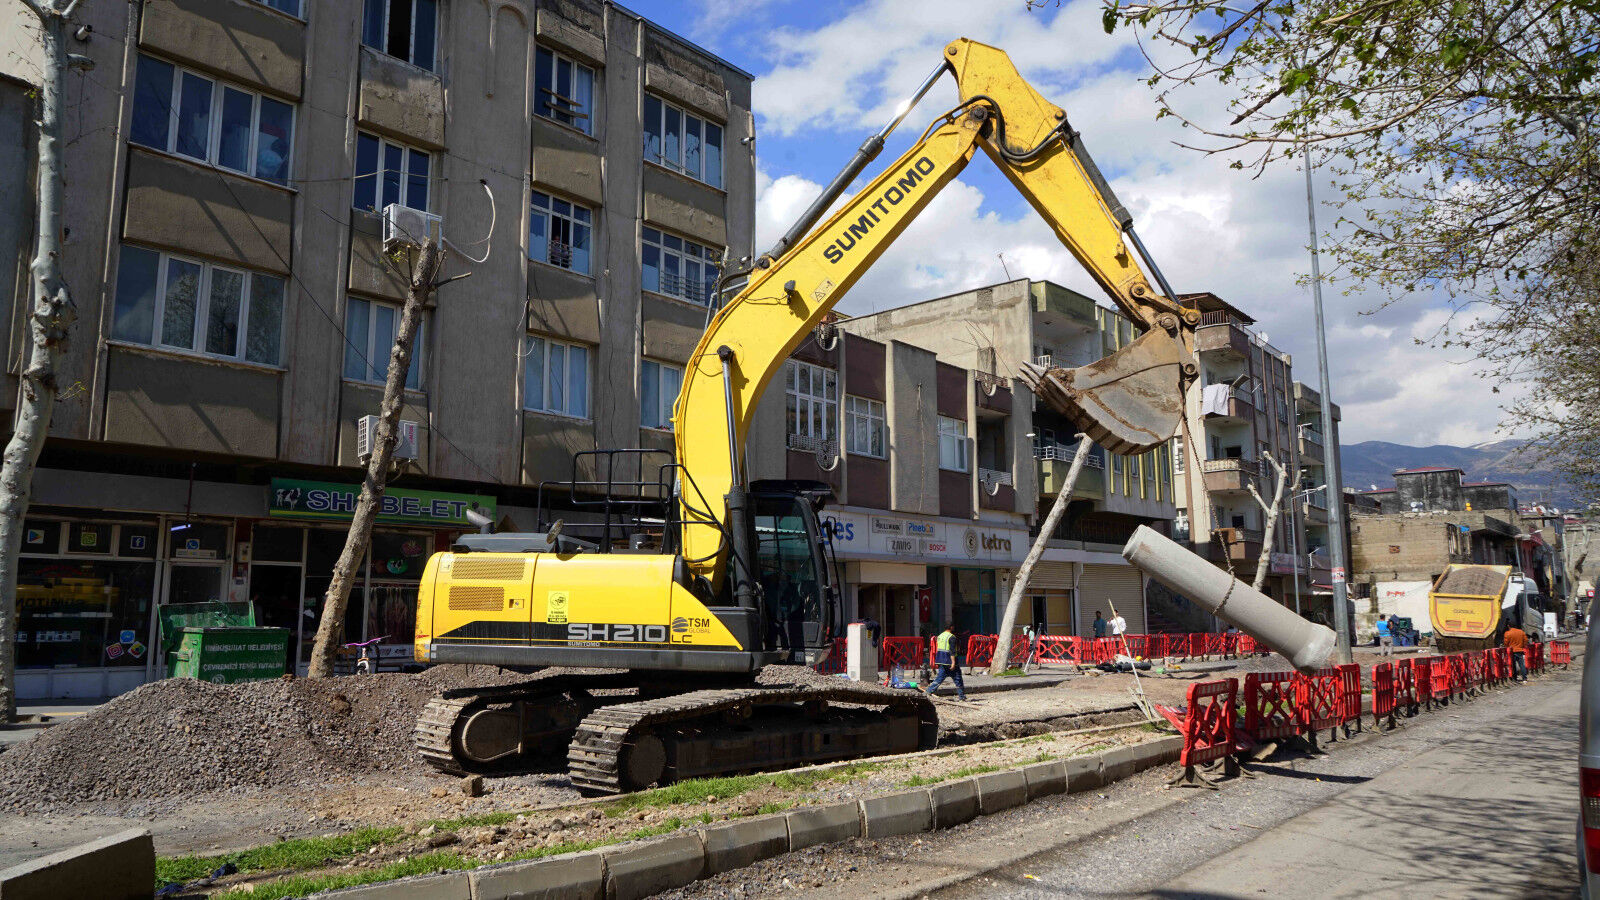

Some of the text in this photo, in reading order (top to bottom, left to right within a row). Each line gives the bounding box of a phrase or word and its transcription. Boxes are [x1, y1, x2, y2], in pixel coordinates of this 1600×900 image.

[823, 156, 935, 265] SUMITOMO
[307, 489, 467, 519] SHBE-ET
[929, 543, 946, 552] BOSCH
[981, 532, 1011, 552] tetra
[688, 617, 710, 628] TSM
[567, 623, 666, 642] SH 210
[671, 634, 692, 643] LC
